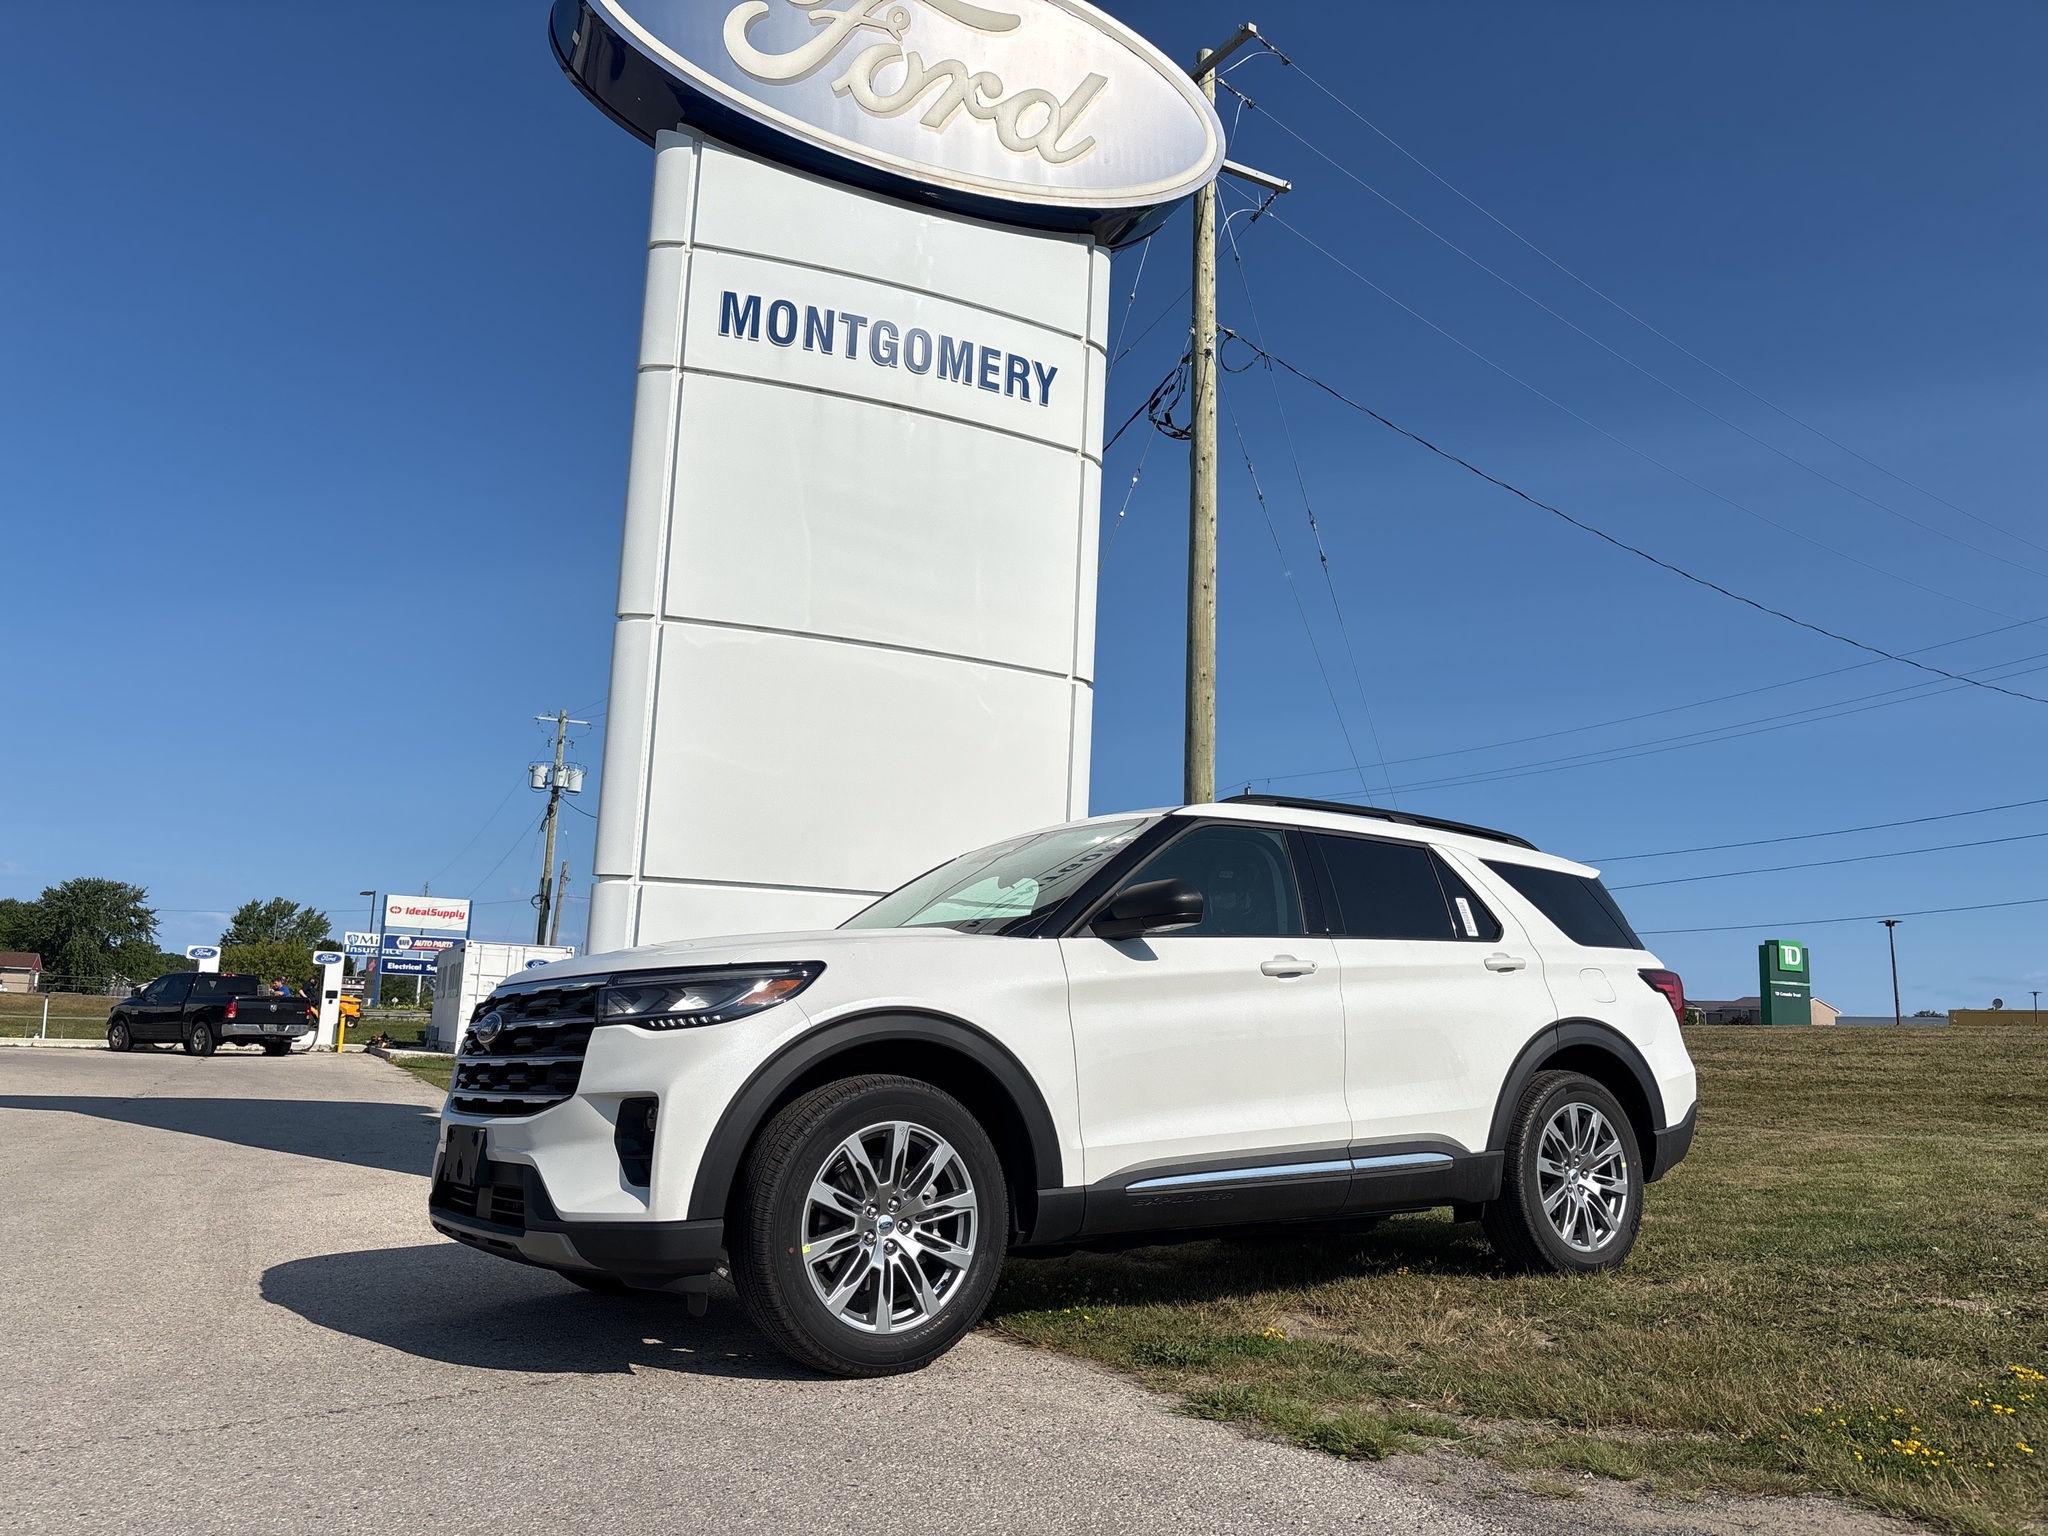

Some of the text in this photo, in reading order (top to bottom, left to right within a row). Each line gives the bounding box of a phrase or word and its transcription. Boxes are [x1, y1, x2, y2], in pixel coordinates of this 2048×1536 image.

[723, 0, 1107, 164] Ford
[718, 290, 1058, 407] MONTGOMERY
[405, 907, 465, 920] IdealSupply
[194, 948, 213, 957] Ford
[320, 953, 337, 962] Ford
[1780, 945, 1801, 966] TD
[387, 962, 422, 971] Electrical
[1132, 1193, 1234, 1207] EXPLORER
